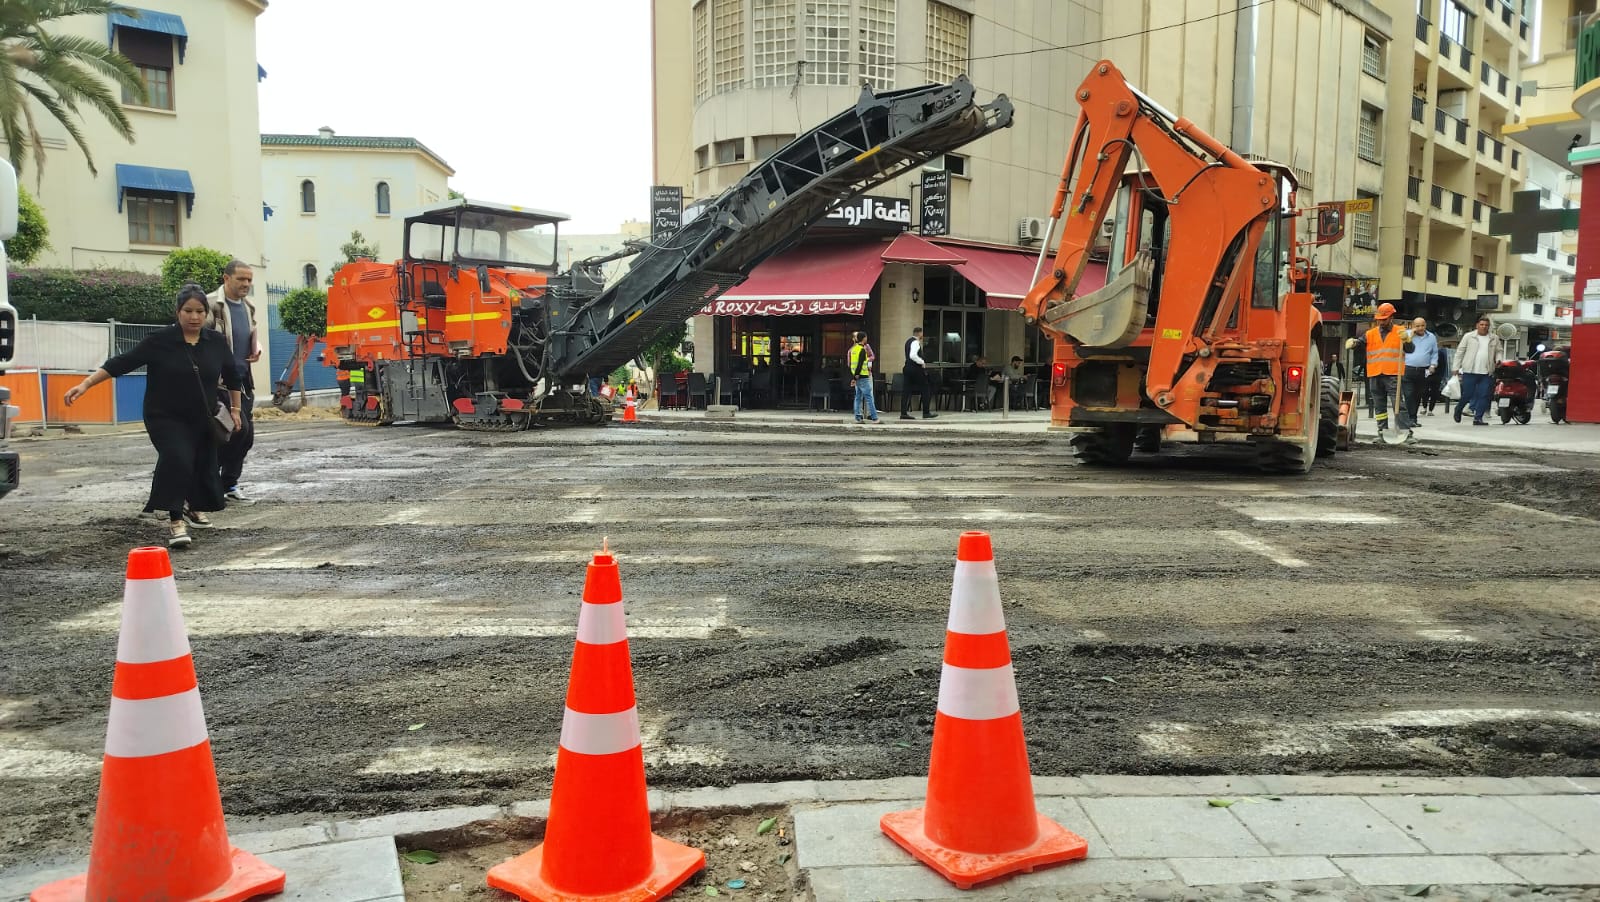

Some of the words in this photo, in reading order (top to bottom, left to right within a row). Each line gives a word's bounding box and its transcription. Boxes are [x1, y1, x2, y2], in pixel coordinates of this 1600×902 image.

[924, 205, 945, 217] Roxy
[655, 217, 679, 228] Roxy
[754, 301, 804, 316] روكسي
[809, 301, 838, 314] الشاي
[841, 301, 863, 312] قاعة
